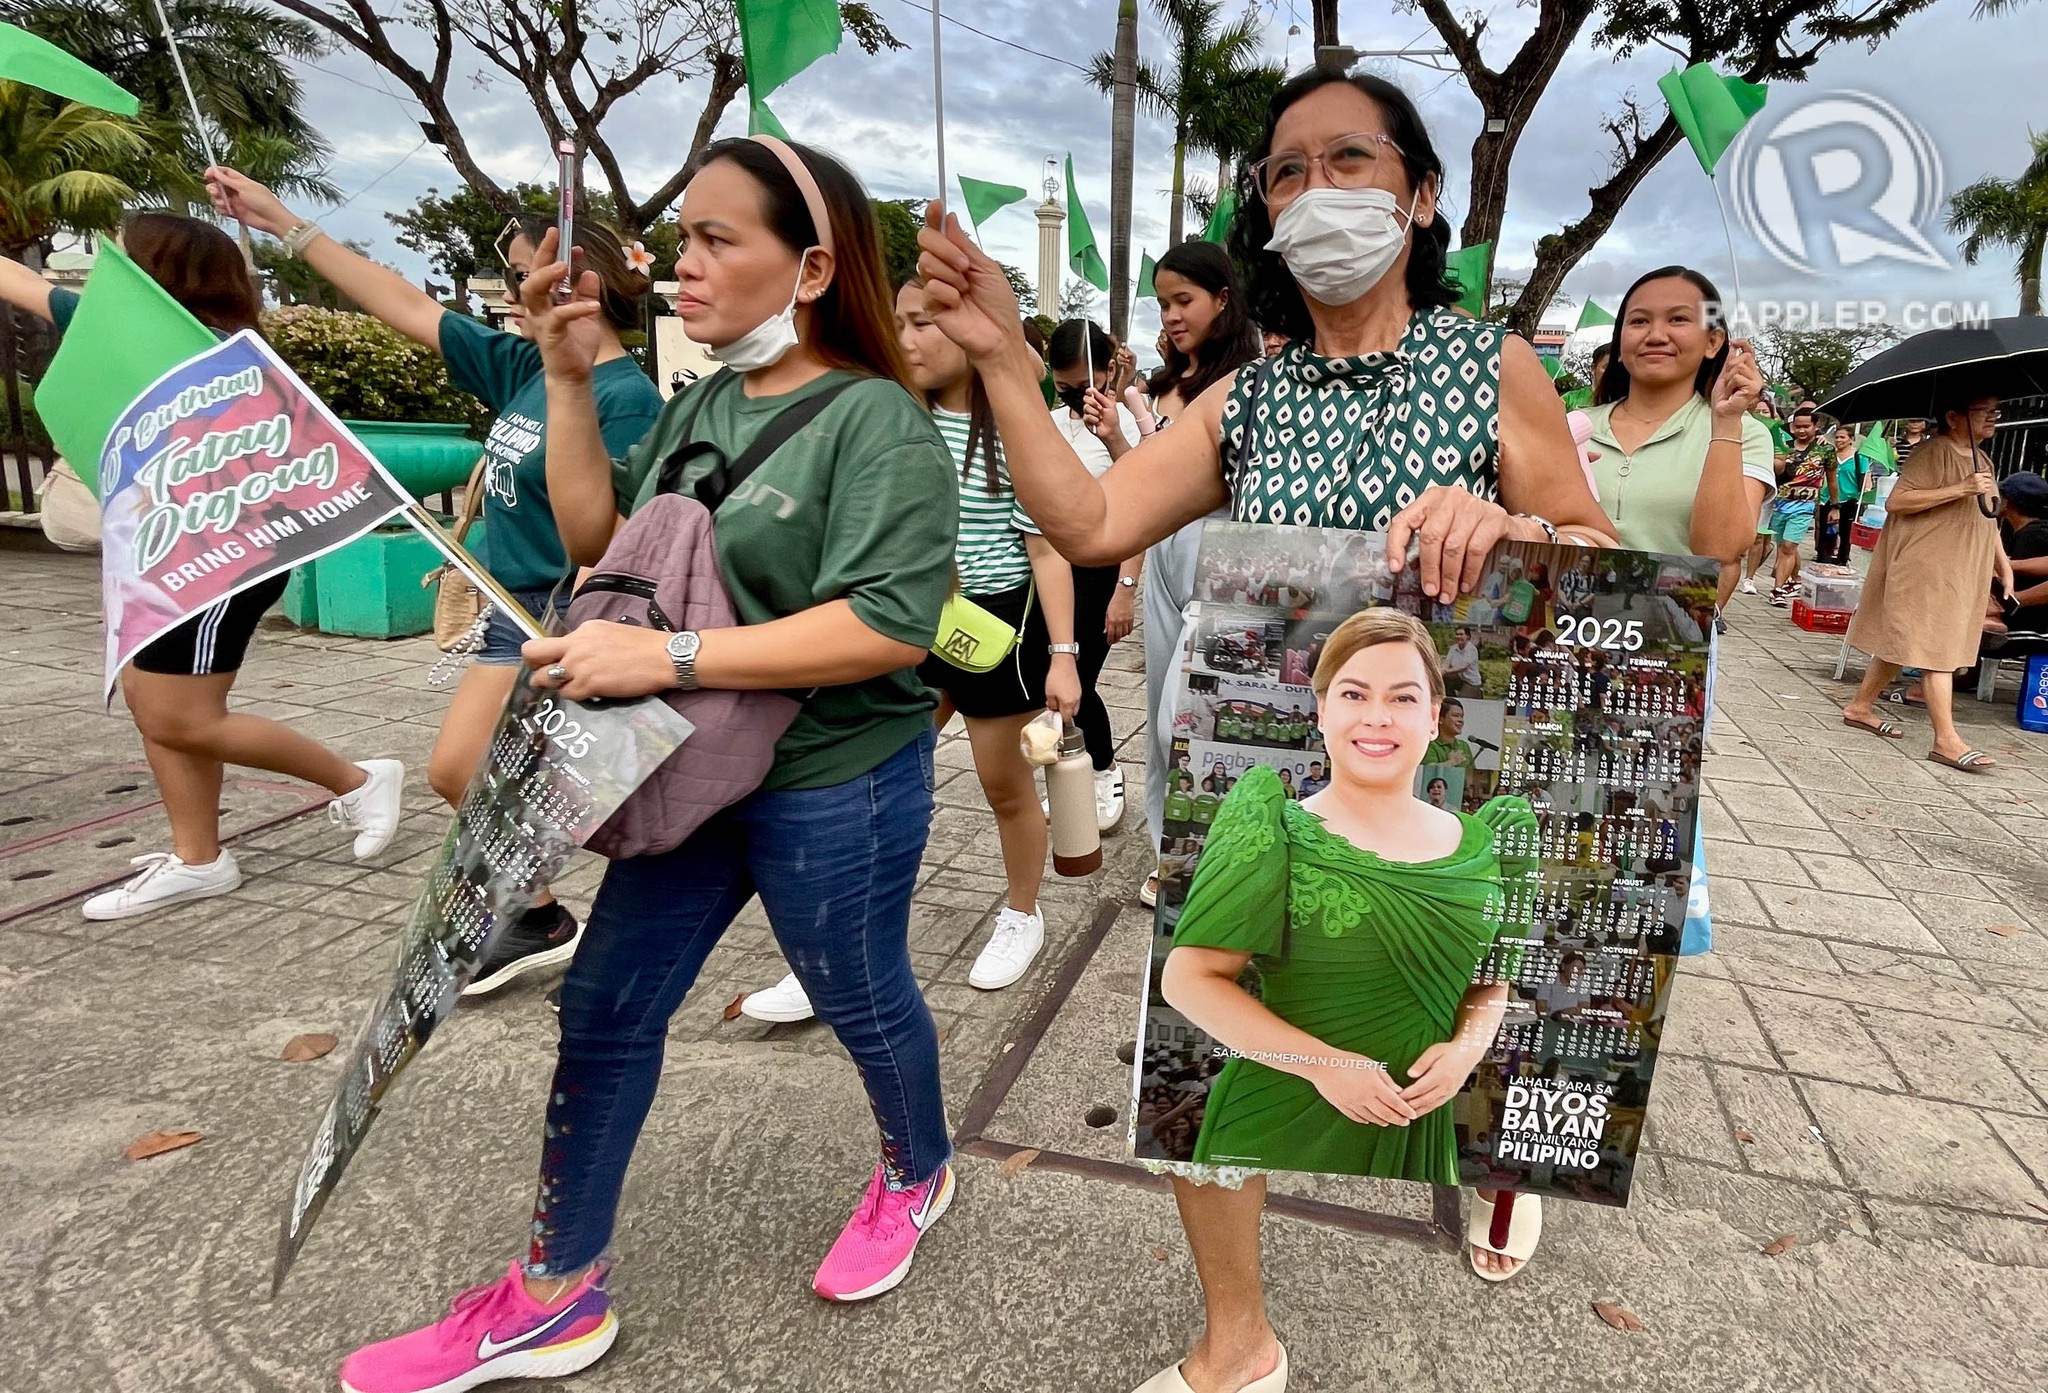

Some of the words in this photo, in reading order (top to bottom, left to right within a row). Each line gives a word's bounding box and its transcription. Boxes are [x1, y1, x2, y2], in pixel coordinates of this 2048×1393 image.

[135, 366, 262, 451] Birthday
[523, 418, 540, 432] NOT
[134, 414, 291, 506] Tatay
[133, 443, 338, 575] Digong
[160, 540, 247, 593] BRING
[245, 515, 303, 550] HIM
[307, 481, 373, 527] HOME
[1555, 614, 1644, 651] 2025
[1534, 650, 1569, 660] JANUARY
[1629, 658, 1668, 668] FEBRUARY
[1236, 680, 1268, 690] SARA
[533, 698, 599, 759] 2025
[1534, 722, 1563, 731] MARCH
[1631, 729, 1654, 738] APRIL
[1533, 801, 1551, 809] MAY
[1624, 808, 1645, 816] JUNE
[1524, 871, 1545, 879] JULY
[1613, 878, 1645, 887] AUGUST
[1499, 936, 1545, 947] SEPTEMBER
[1601, 945, 1639, 955] OCTOBER
[1581, 1008, 1623, 1019] DECEMBER
[1212, 1047, 1246, 1059] SARA
[1250, 1050, 1328, 1066] ZIMMERMAN
[1330, 1057, 1388, 1072] DUTERTE
[1509, 1075, 1592, 1093] LAHAT-PARA
[1596, 1084, 1614, 1097] SA
[1501, 1108, 1605, 1140] BAYAN
[1501, 1130, 1521, 1141] AT
[1522, 1131, 1599, 1150] PAMILYANG
[1498, 1140, 1600, 1170] PILIPINO
